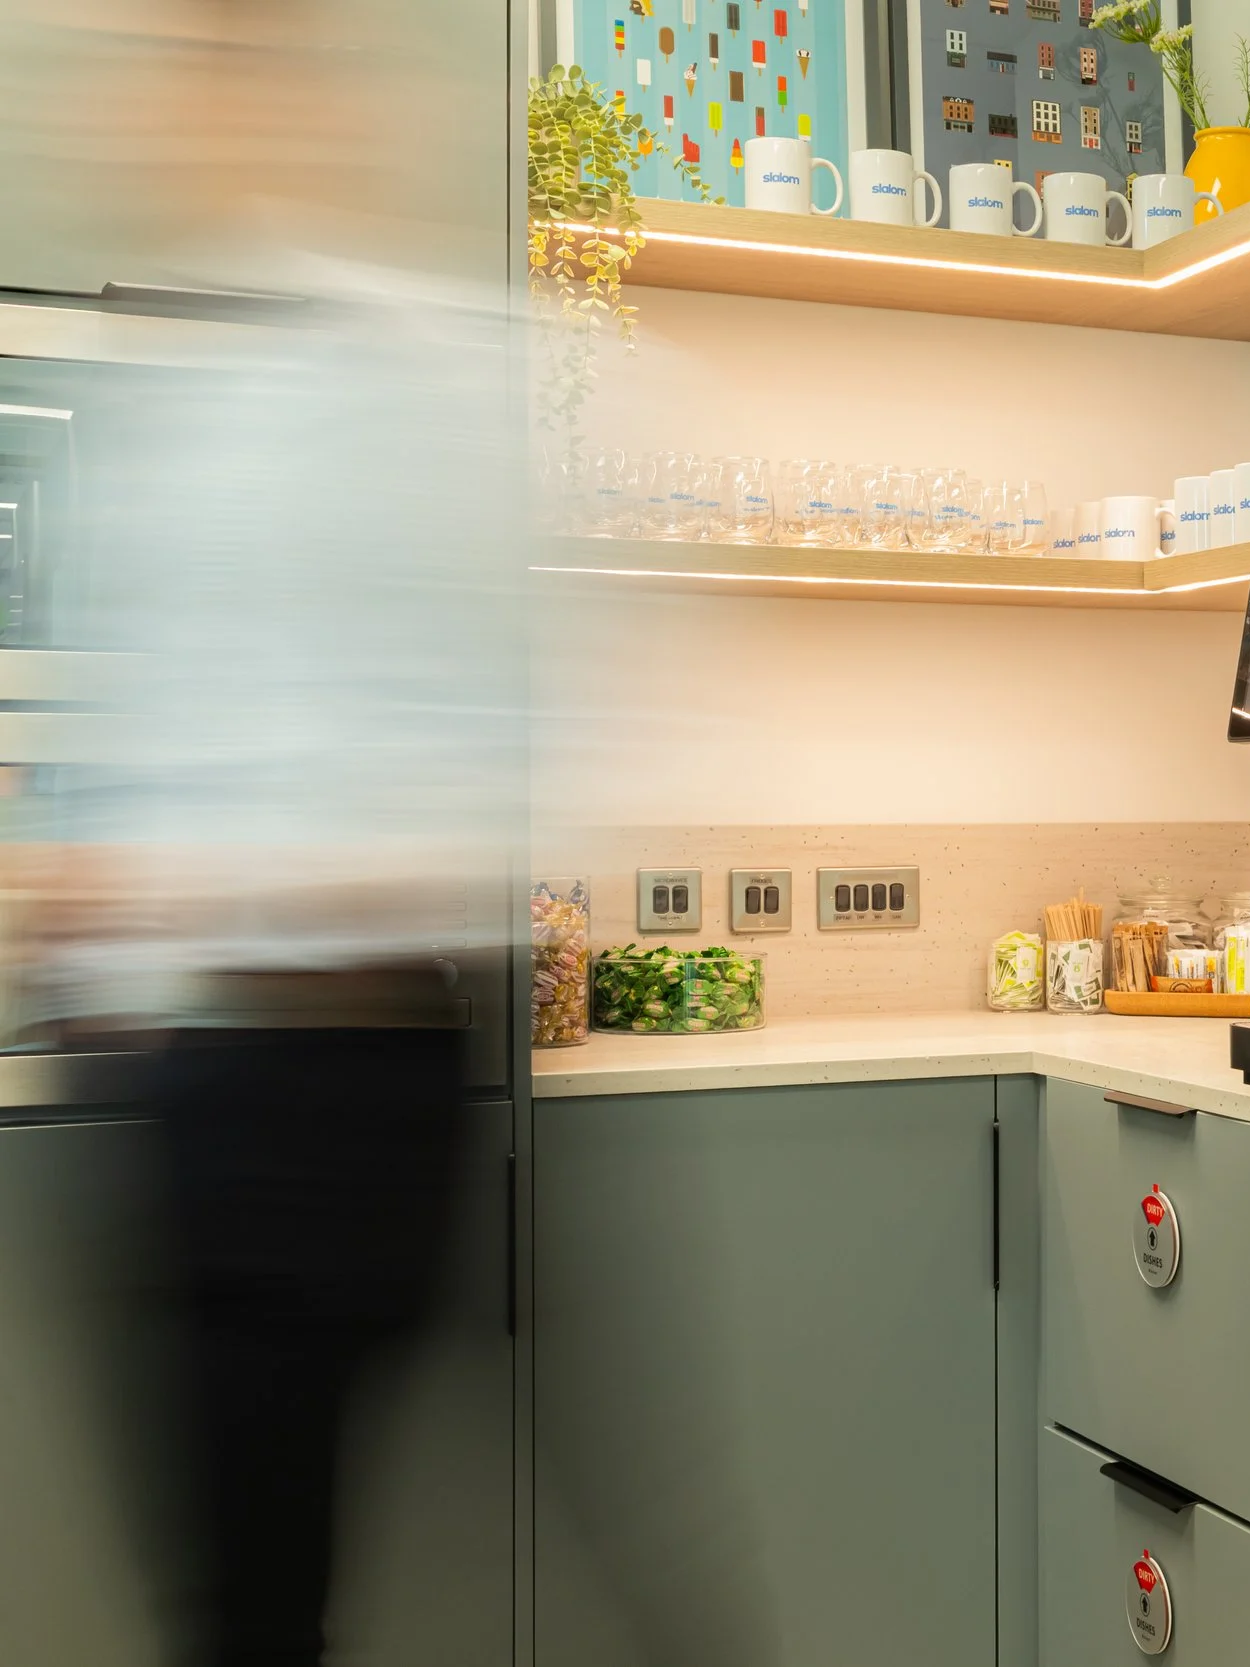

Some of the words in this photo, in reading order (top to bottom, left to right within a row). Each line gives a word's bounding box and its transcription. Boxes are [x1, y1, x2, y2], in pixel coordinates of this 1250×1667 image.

[763, 172, 800, 185] slalom
[871, 183, 907, 196] slalom
[968, 197, 1003, 209] slalom
[1065, 205, 1099, 218] slalom
[1147, 206, 1182, 218] slalom
[808, 500, 833, 509] slalom
[876, 502, 898, 510] slalom
[1104, 528, 1136, 539] slalom
[1146, 1203, 1163, 1217] DIRTY
[1143, 1253, 1163, 1269] DISHES
[1138, 1568, 1155, 1584] DIRTY
[1136, 1618, 1156, 1636] DISHES
